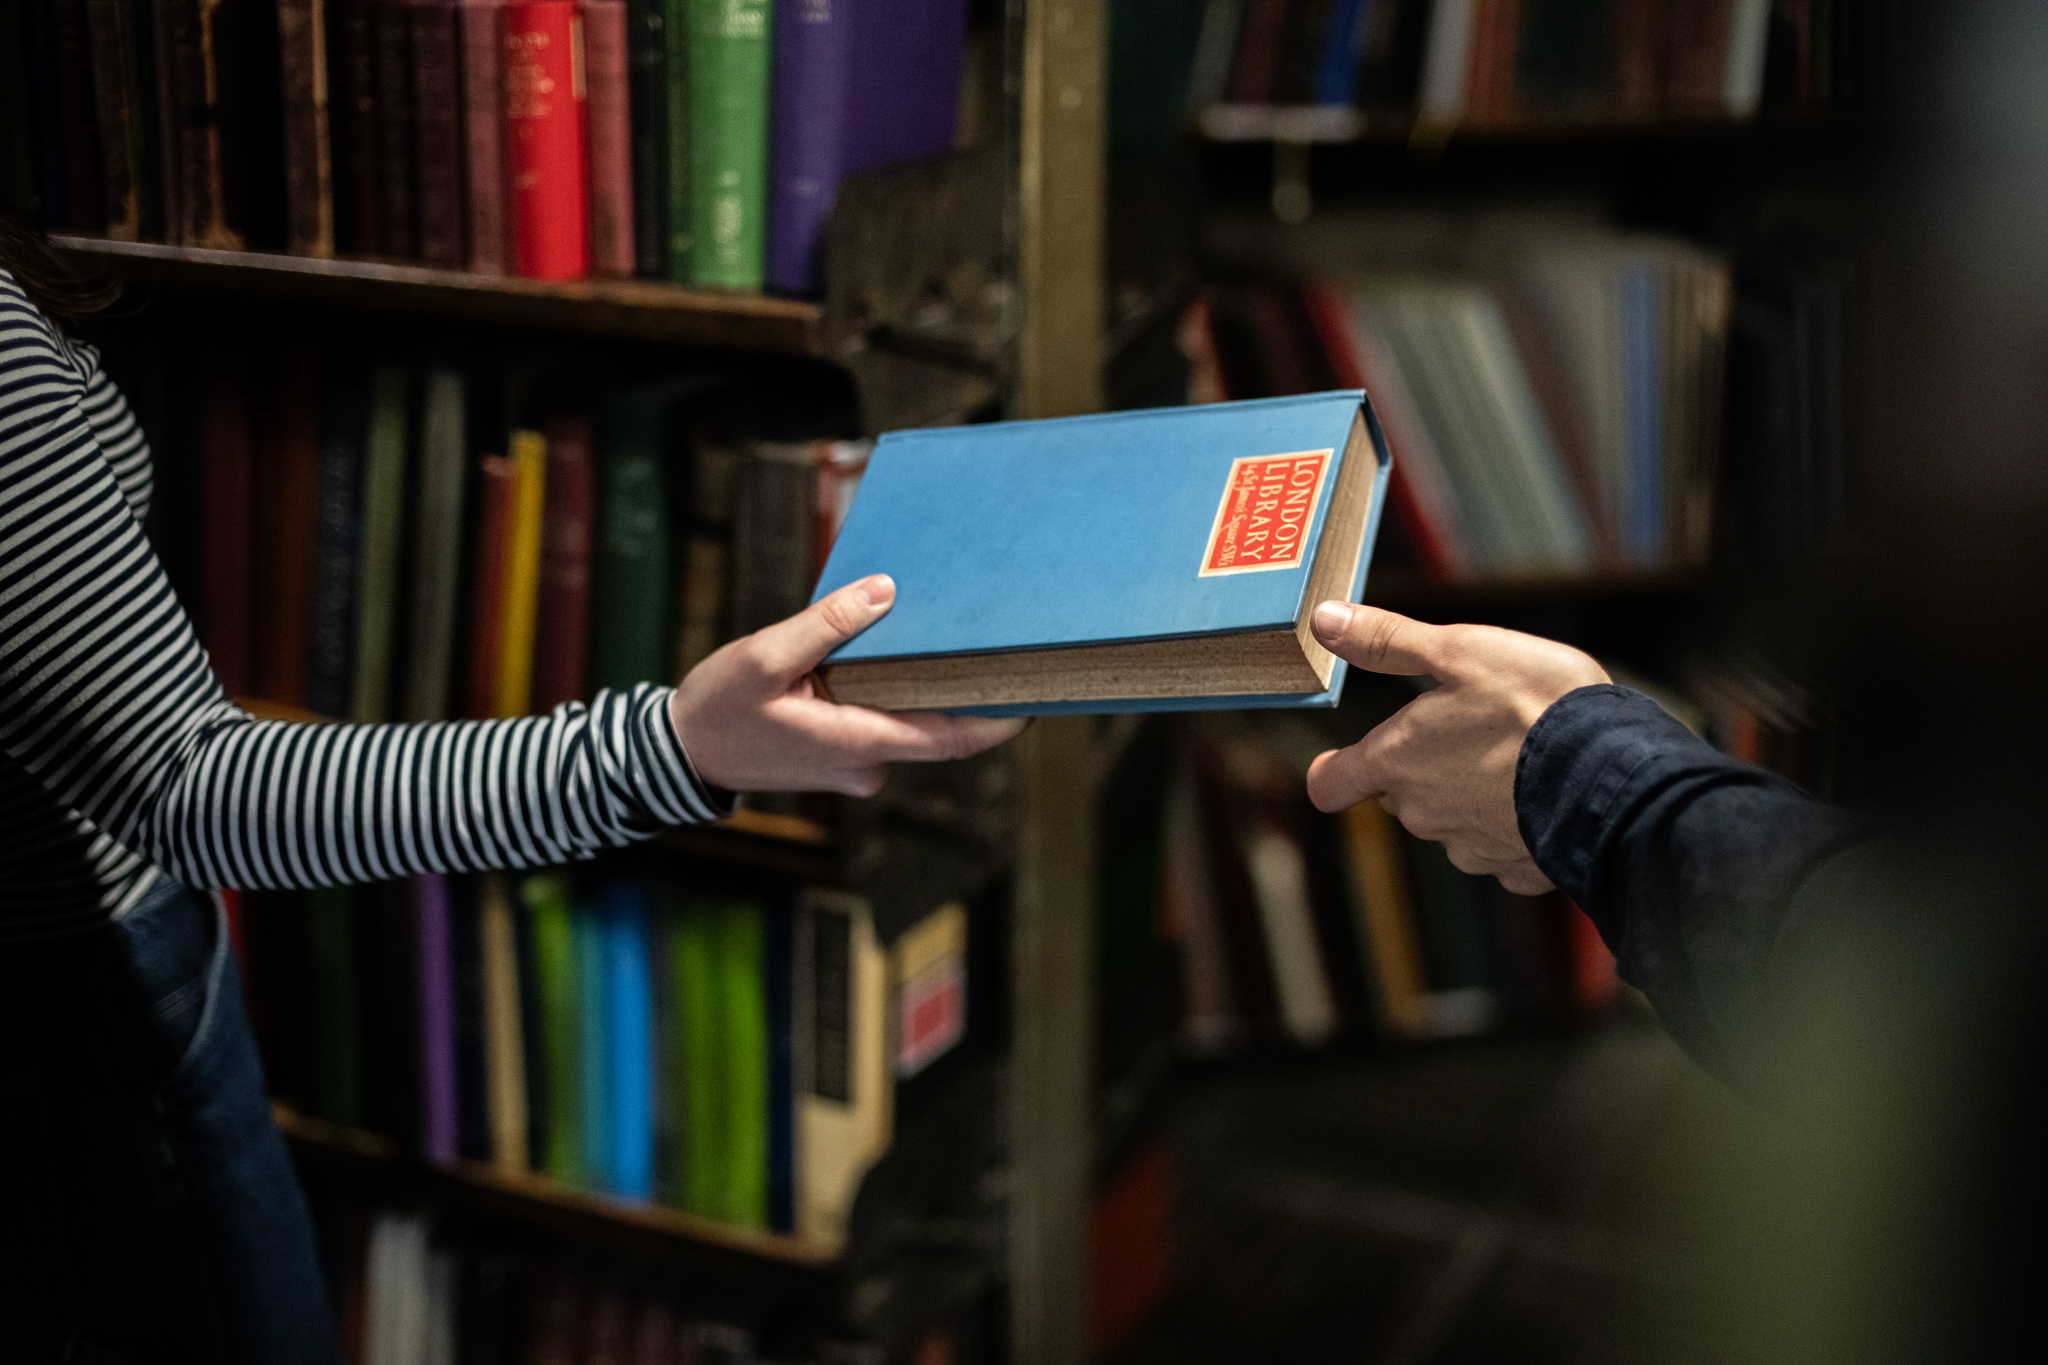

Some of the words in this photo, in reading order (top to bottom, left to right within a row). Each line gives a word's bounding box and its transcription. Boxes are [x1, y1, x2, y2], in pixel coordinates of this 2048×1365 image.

[1241, 464, 1258, 475] 14
[1220, 513, 1247, 544] Square
[1240, 461, 1290, 560] LIBRARY
[1269, 458, 1319, 560] LONDON
